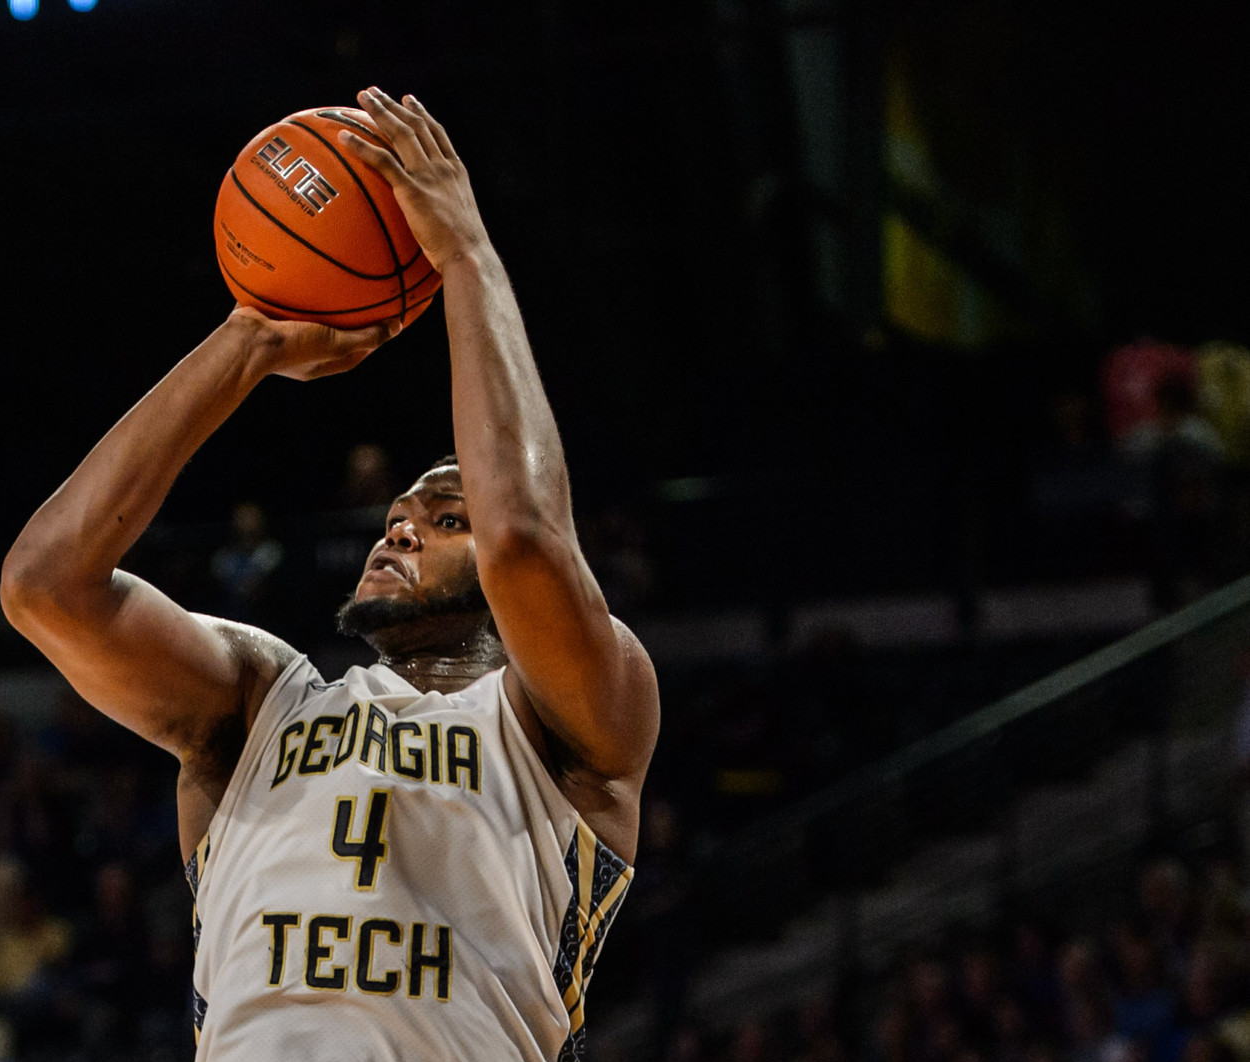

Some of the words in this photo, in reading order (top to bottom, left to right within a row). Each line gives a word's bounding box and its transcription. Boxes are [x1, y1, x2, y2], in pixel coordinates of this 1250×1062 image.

[250, 156, 316, 217] CHAMPIONSHIP
[256, 136, 340, 213] ELITE
[269, 701, 482, 795] GEORGIA
[329, 788, 393, 892] 4
[261, 911, 453, 1002] TECH
